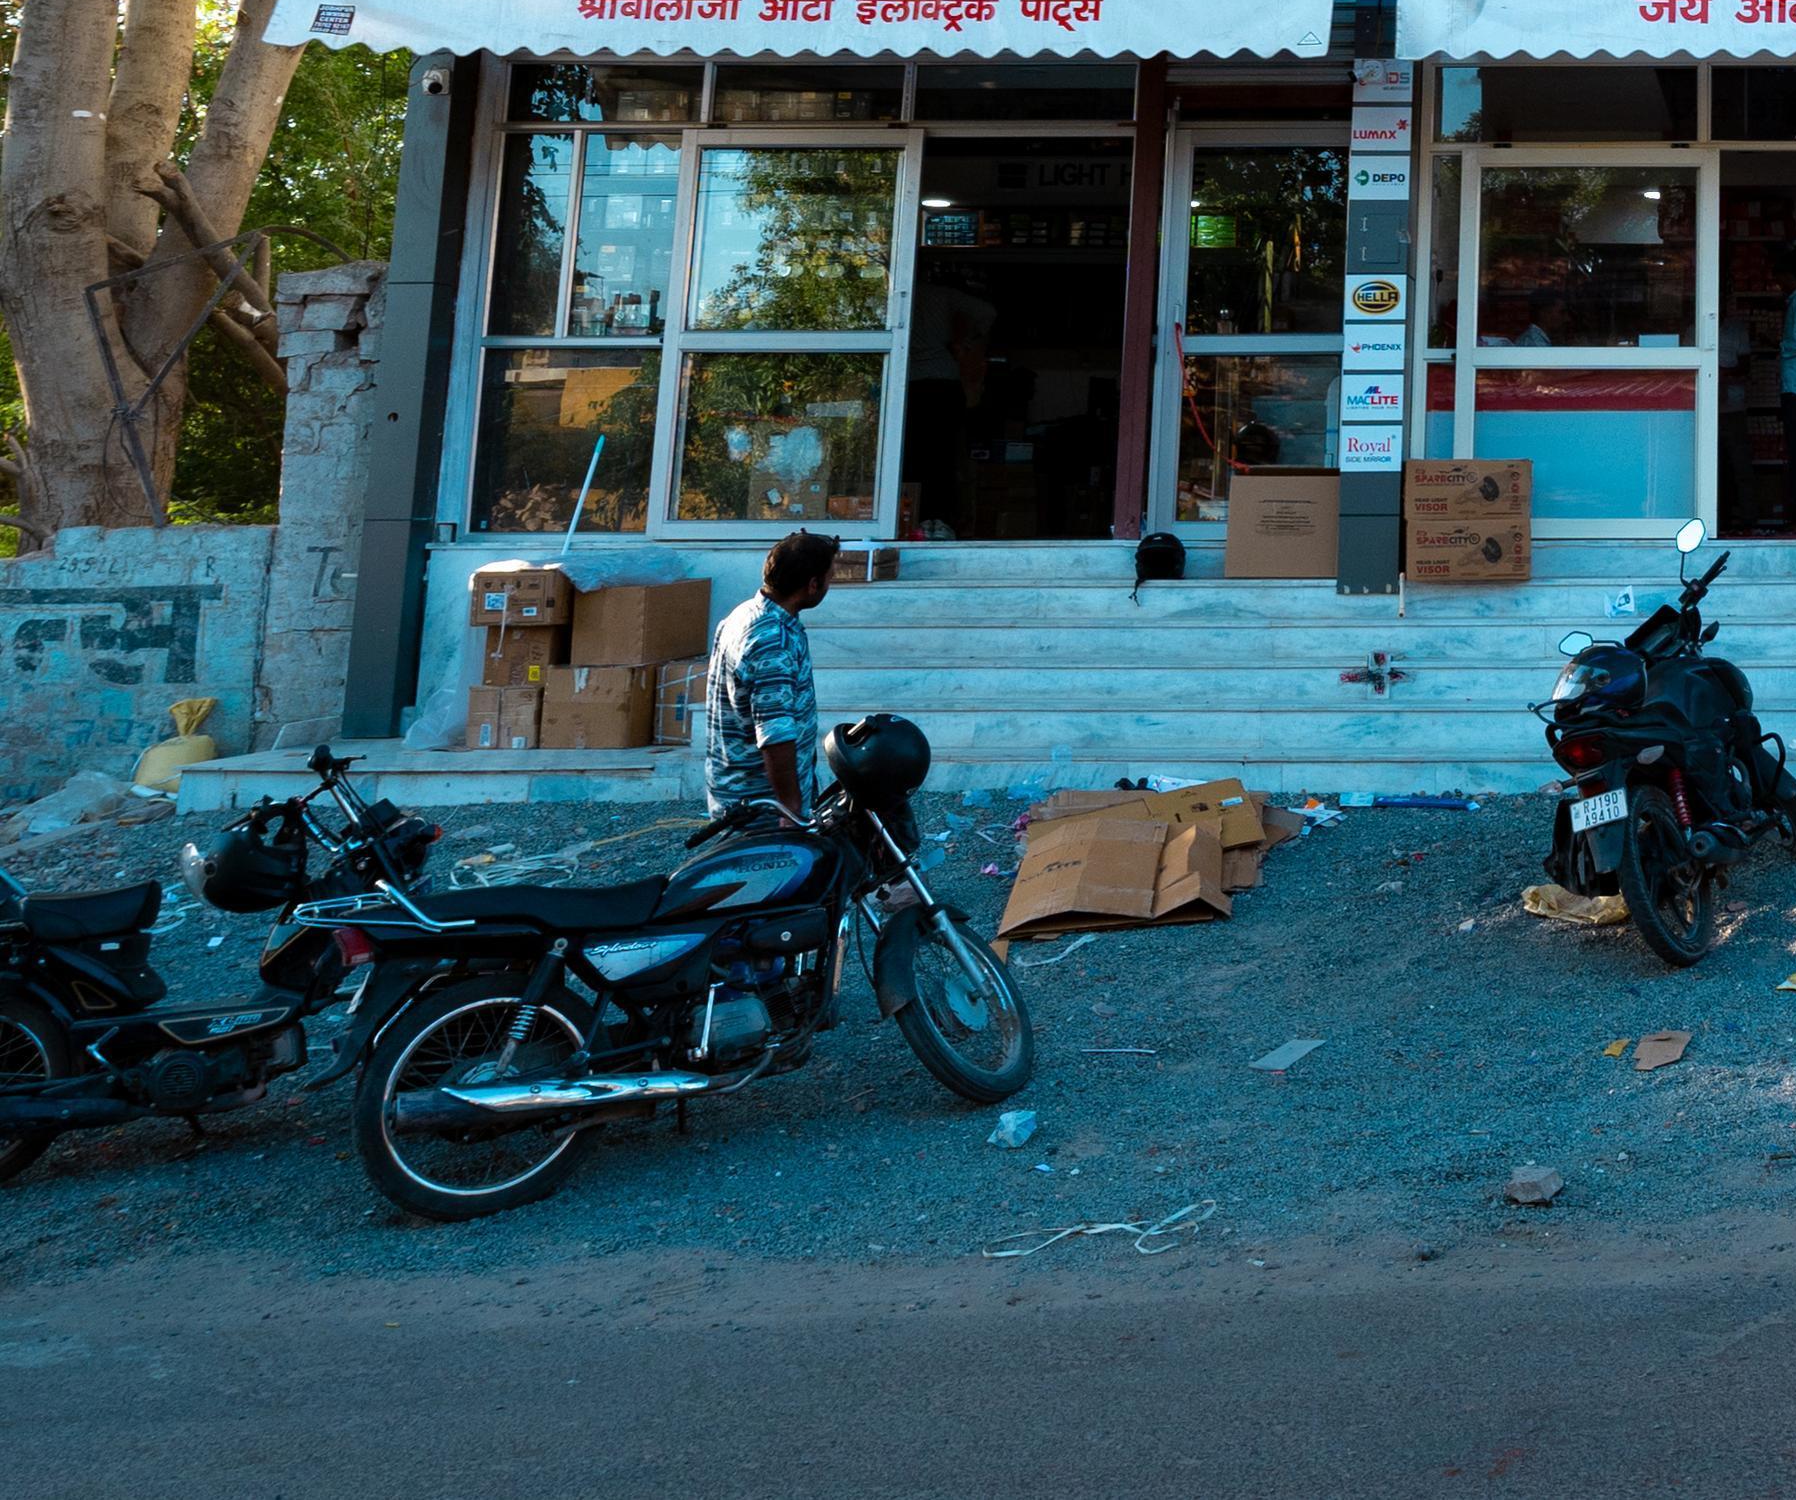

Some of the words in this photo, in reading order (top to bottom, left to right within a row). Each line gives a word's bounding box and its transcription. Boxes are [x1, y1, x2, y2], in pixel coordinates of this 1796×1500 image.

[1353, 130, 1397, 139] LUMAX
[1372, 173, 1405, 183] DEPO
[1357, 291, 1399, 302] HELLA
[1361, 343, 1402, 351] PHOENIX
[1347, 395, 1399, 405] MACLITE
[1347, 437, 1391, 456] Royal
[1414, 503, 1449, 511] VISOR
[1416, 565, 1450, 574] VISOR
[1585, 805, 1620, 827] A9410
[738, 859, 799, 873] HONDA
